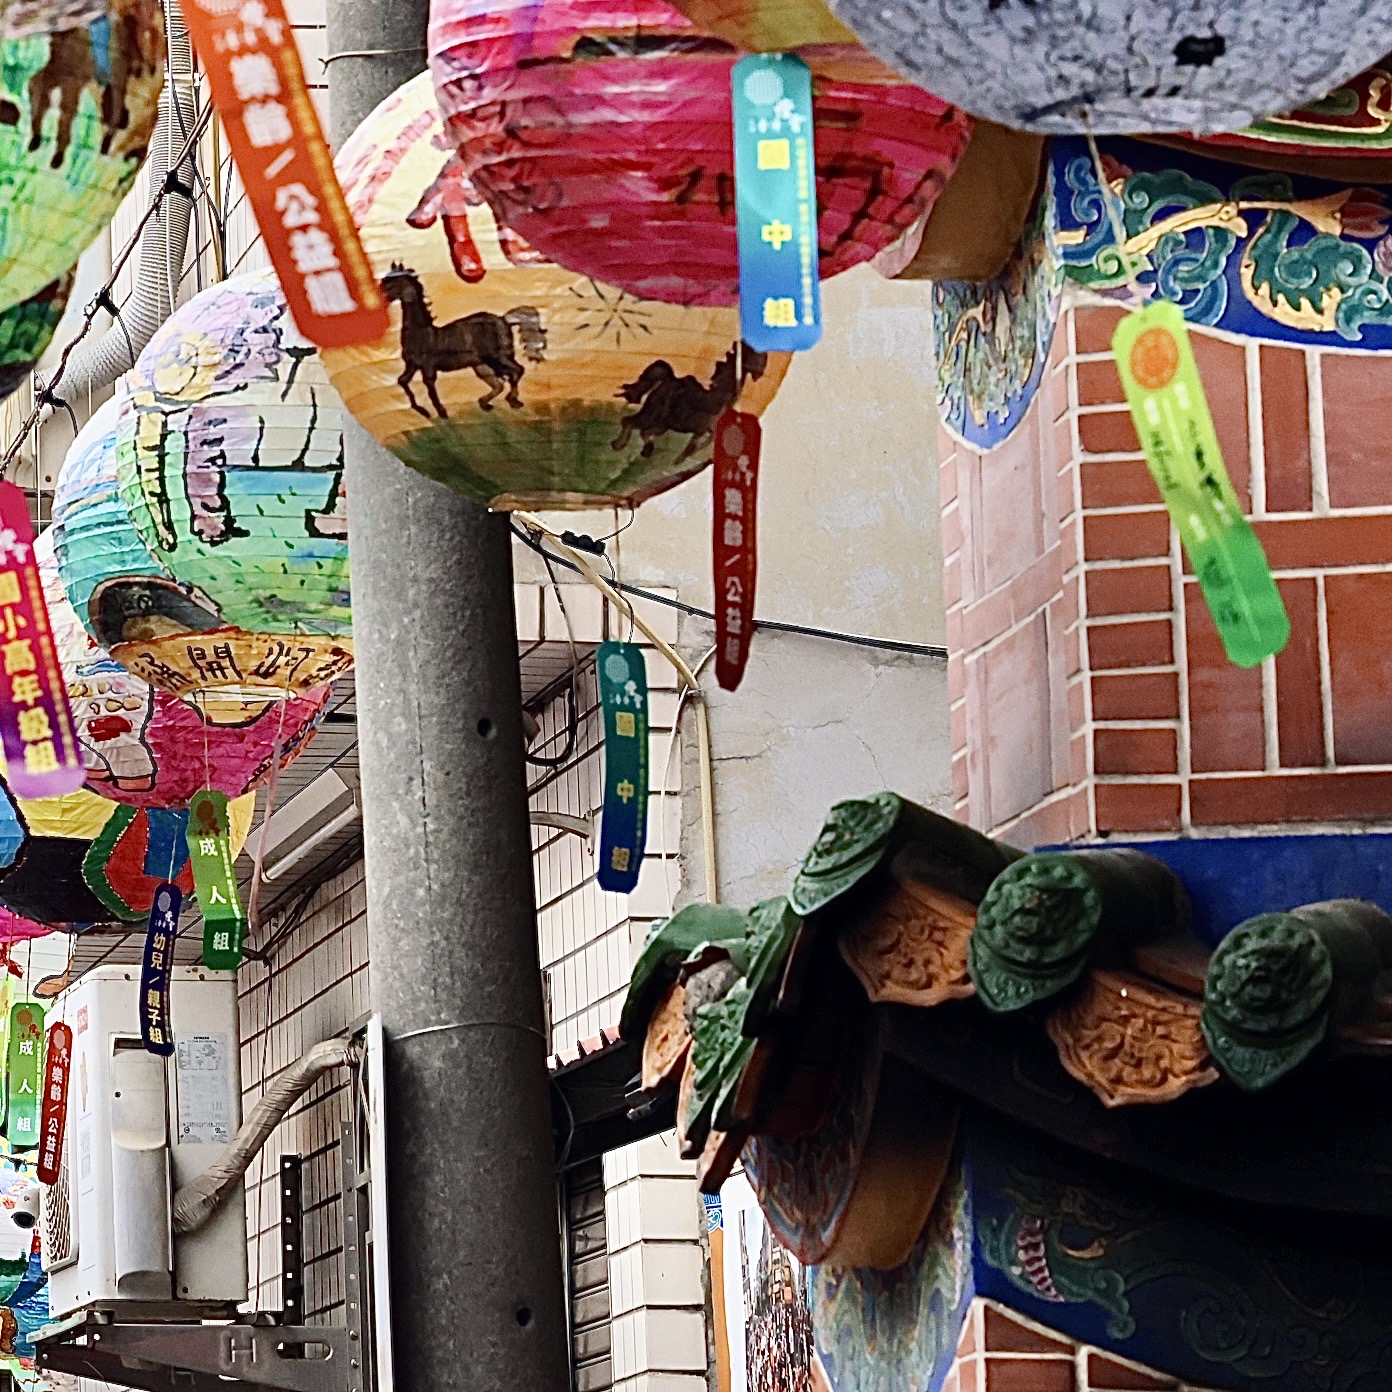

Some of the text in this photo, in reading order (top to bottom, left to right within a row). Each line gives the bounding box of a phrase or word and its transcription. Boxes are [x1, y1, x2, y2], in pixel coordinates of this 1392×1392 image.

[199, 839, 230, 951] 成人組
[16, 1040, 34, 1133] 成人組
[43, 1065, 63, 1170] 樂齡/公益組
